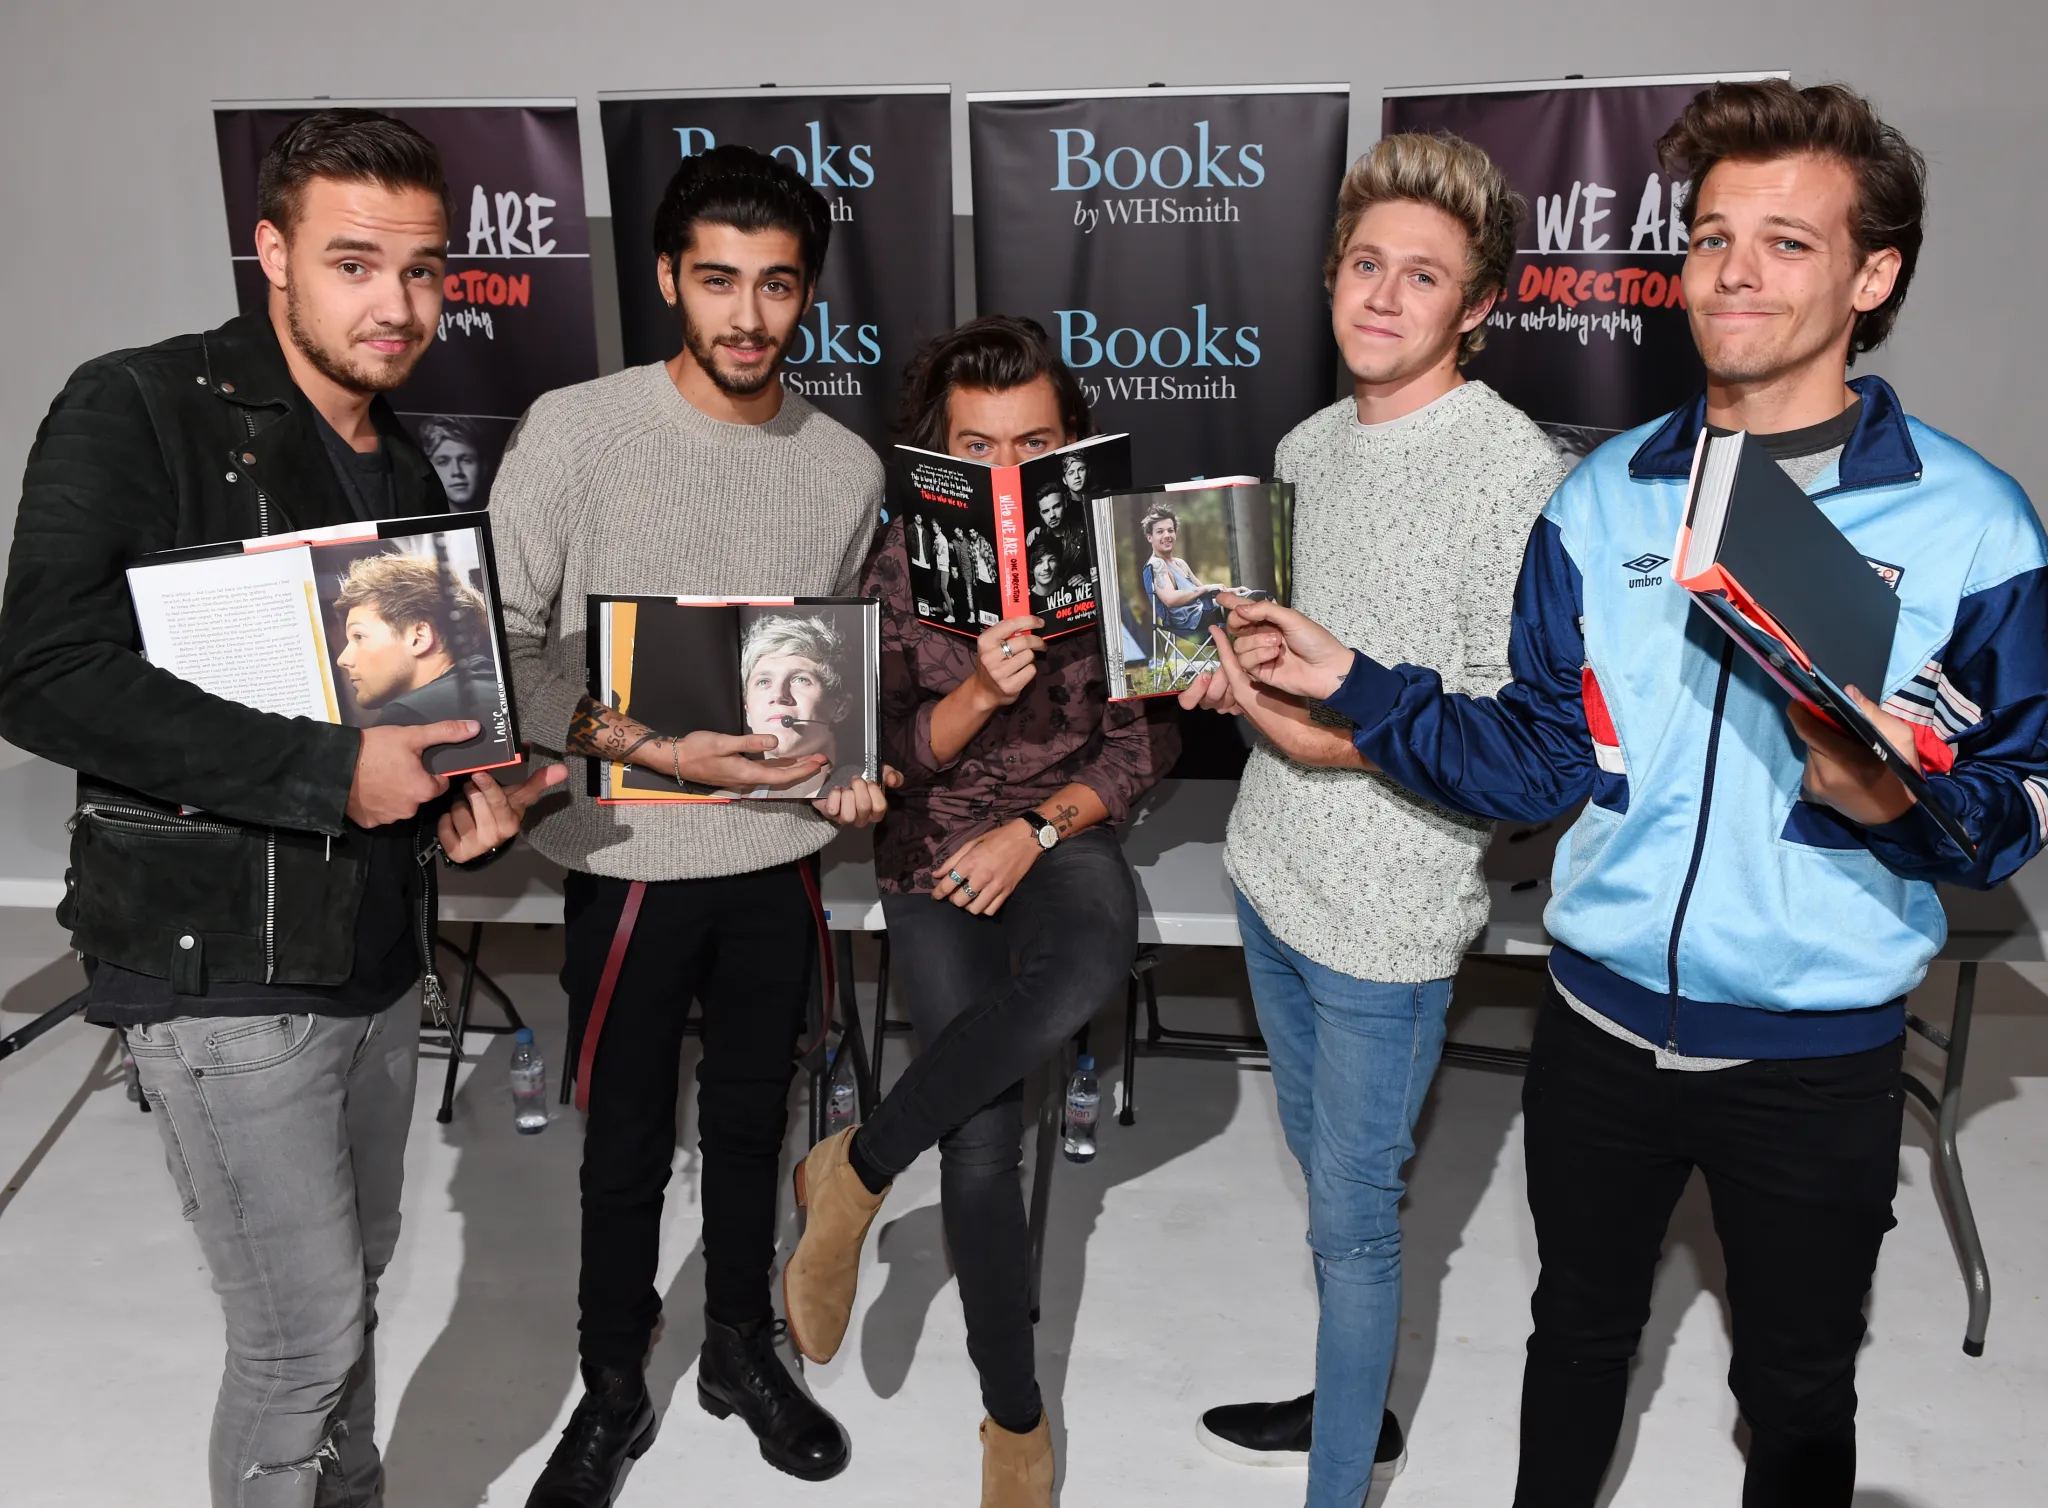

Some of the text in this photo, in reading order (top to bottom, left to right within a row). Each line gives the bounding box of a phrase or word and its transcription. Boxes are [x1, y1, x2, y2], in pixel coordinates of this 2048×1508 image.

[1049, 120, 1265, 191] Books
[466, 184, 557, 259] ARE
[1073, 197, 1240, 234] by WHSmith
[1536, 172, 1690, 256] WE AR
[443, 269, 531, 307] CTION
[1517, 264, 1687, 310] DIRECTION
[784, 301, 882, 365] oks
[1053, 303, 1261, 369] Books
[1520, 303, 1643, 346] autobiography
[779, 371, 863, 396] Smith
[1104, 375, 1237, 401] WHSmith
[1074, 583, 1092, 602] WE
[1629, 575, 1662, 588] umbro
[1055, 607, 1072, 619] ONE
